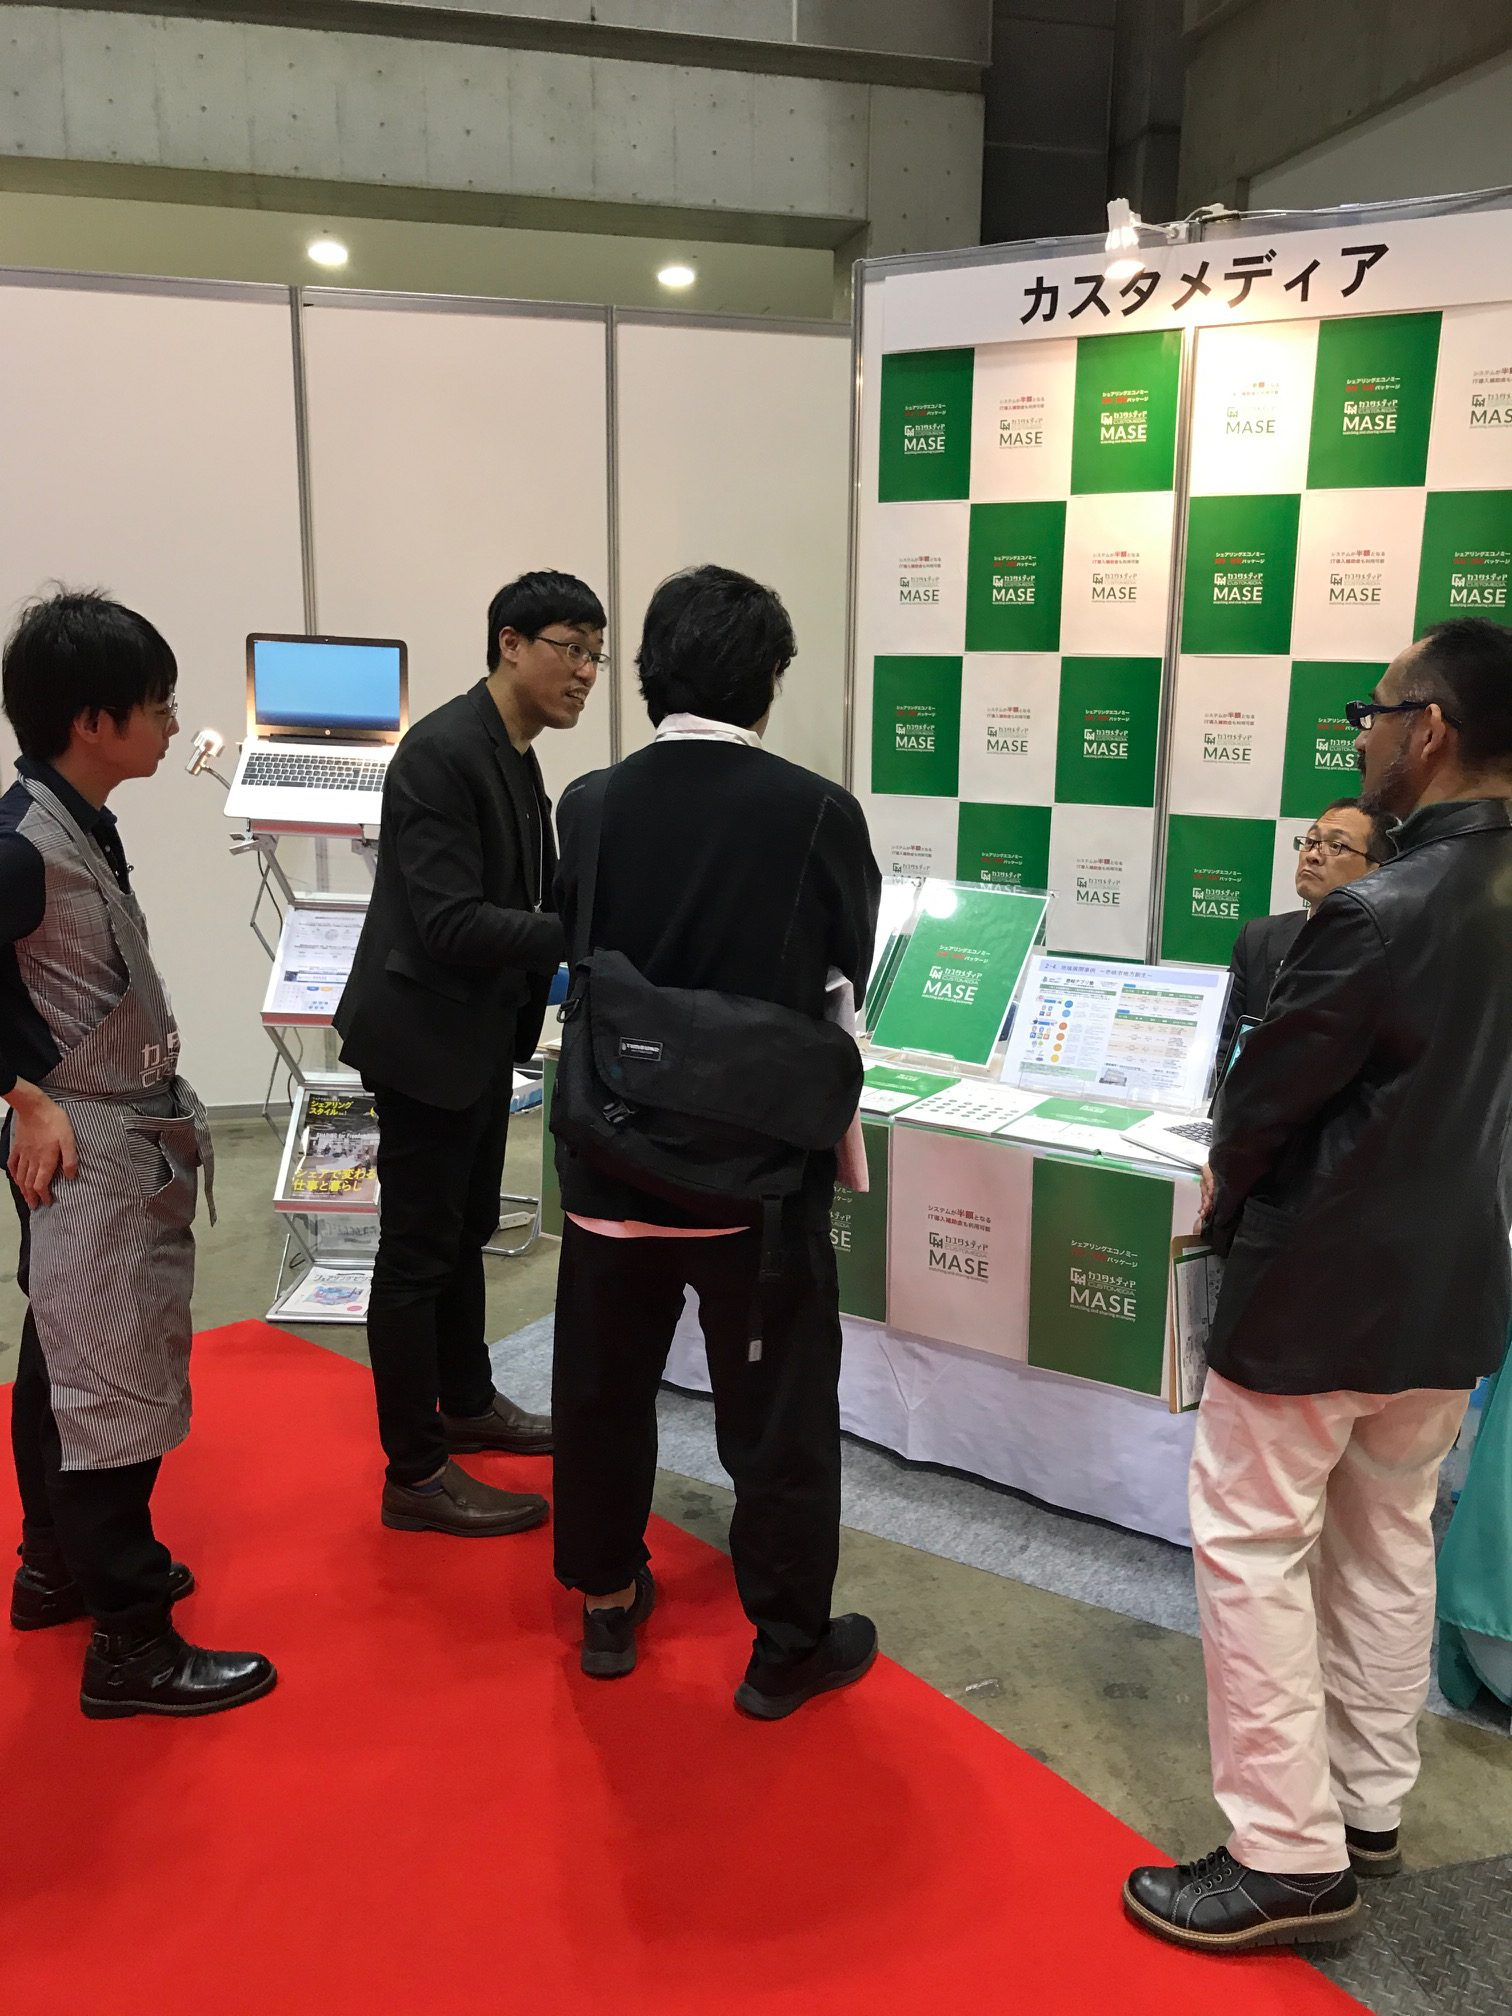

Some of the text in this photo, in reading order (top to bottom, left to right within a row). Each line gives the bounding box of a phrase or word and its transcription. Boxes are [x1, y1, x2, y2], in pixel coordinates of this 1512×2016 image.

[1019, 243, 1389, 326] カスタメディア
[1226, 419, 1276, 435] MASE
[1343, 414, 1398, 431] MASE
[999, 431, 1043, 446] MASE
[1100, 424, 1148, 440] MASE
[904, 436, 946, 451] MASE
[899, 589, 940, 602] MASE
[992, 587, 1036, 602] MASE
[1092, 586, 1137, 600] MASE
[1213, 586, 1263, 601] MASE
[1329, 587, 1382, 602] MASE
[1450, 588, 1508, 604] MASE
[895, 736, 935, 750] MASE
[987, 739, 1029, 753] MASE
[1083, 741, 1129, 757] MASE
[1203, 746, 1252, 762] MASE
[1076, 889, 1121, 904] MASE
[1192, 900, 1240, 917] MASE
[923, 979, 978, 1002] MASE
[309, 1107, 338, 1116] スタイル
[311, 1100, 354, 1109] シェアリング
[295, 1167, 377, 1180] シェアで変わる
[293, 1179, 362, 1192] 仕事と暮らし
[928, 1205, 991, 1223] システムが半額となる
[927, 1214, 991, 1232] IT導入補助金も利用可能
[1071, 1240, 1138, 1258] シェアリングエコノミー
[929, 1249, 989, 1279] MASE
[1107, 1257, 1138, 1268] パッケージ
[1070, 1286, 1137, 1317] MASE
